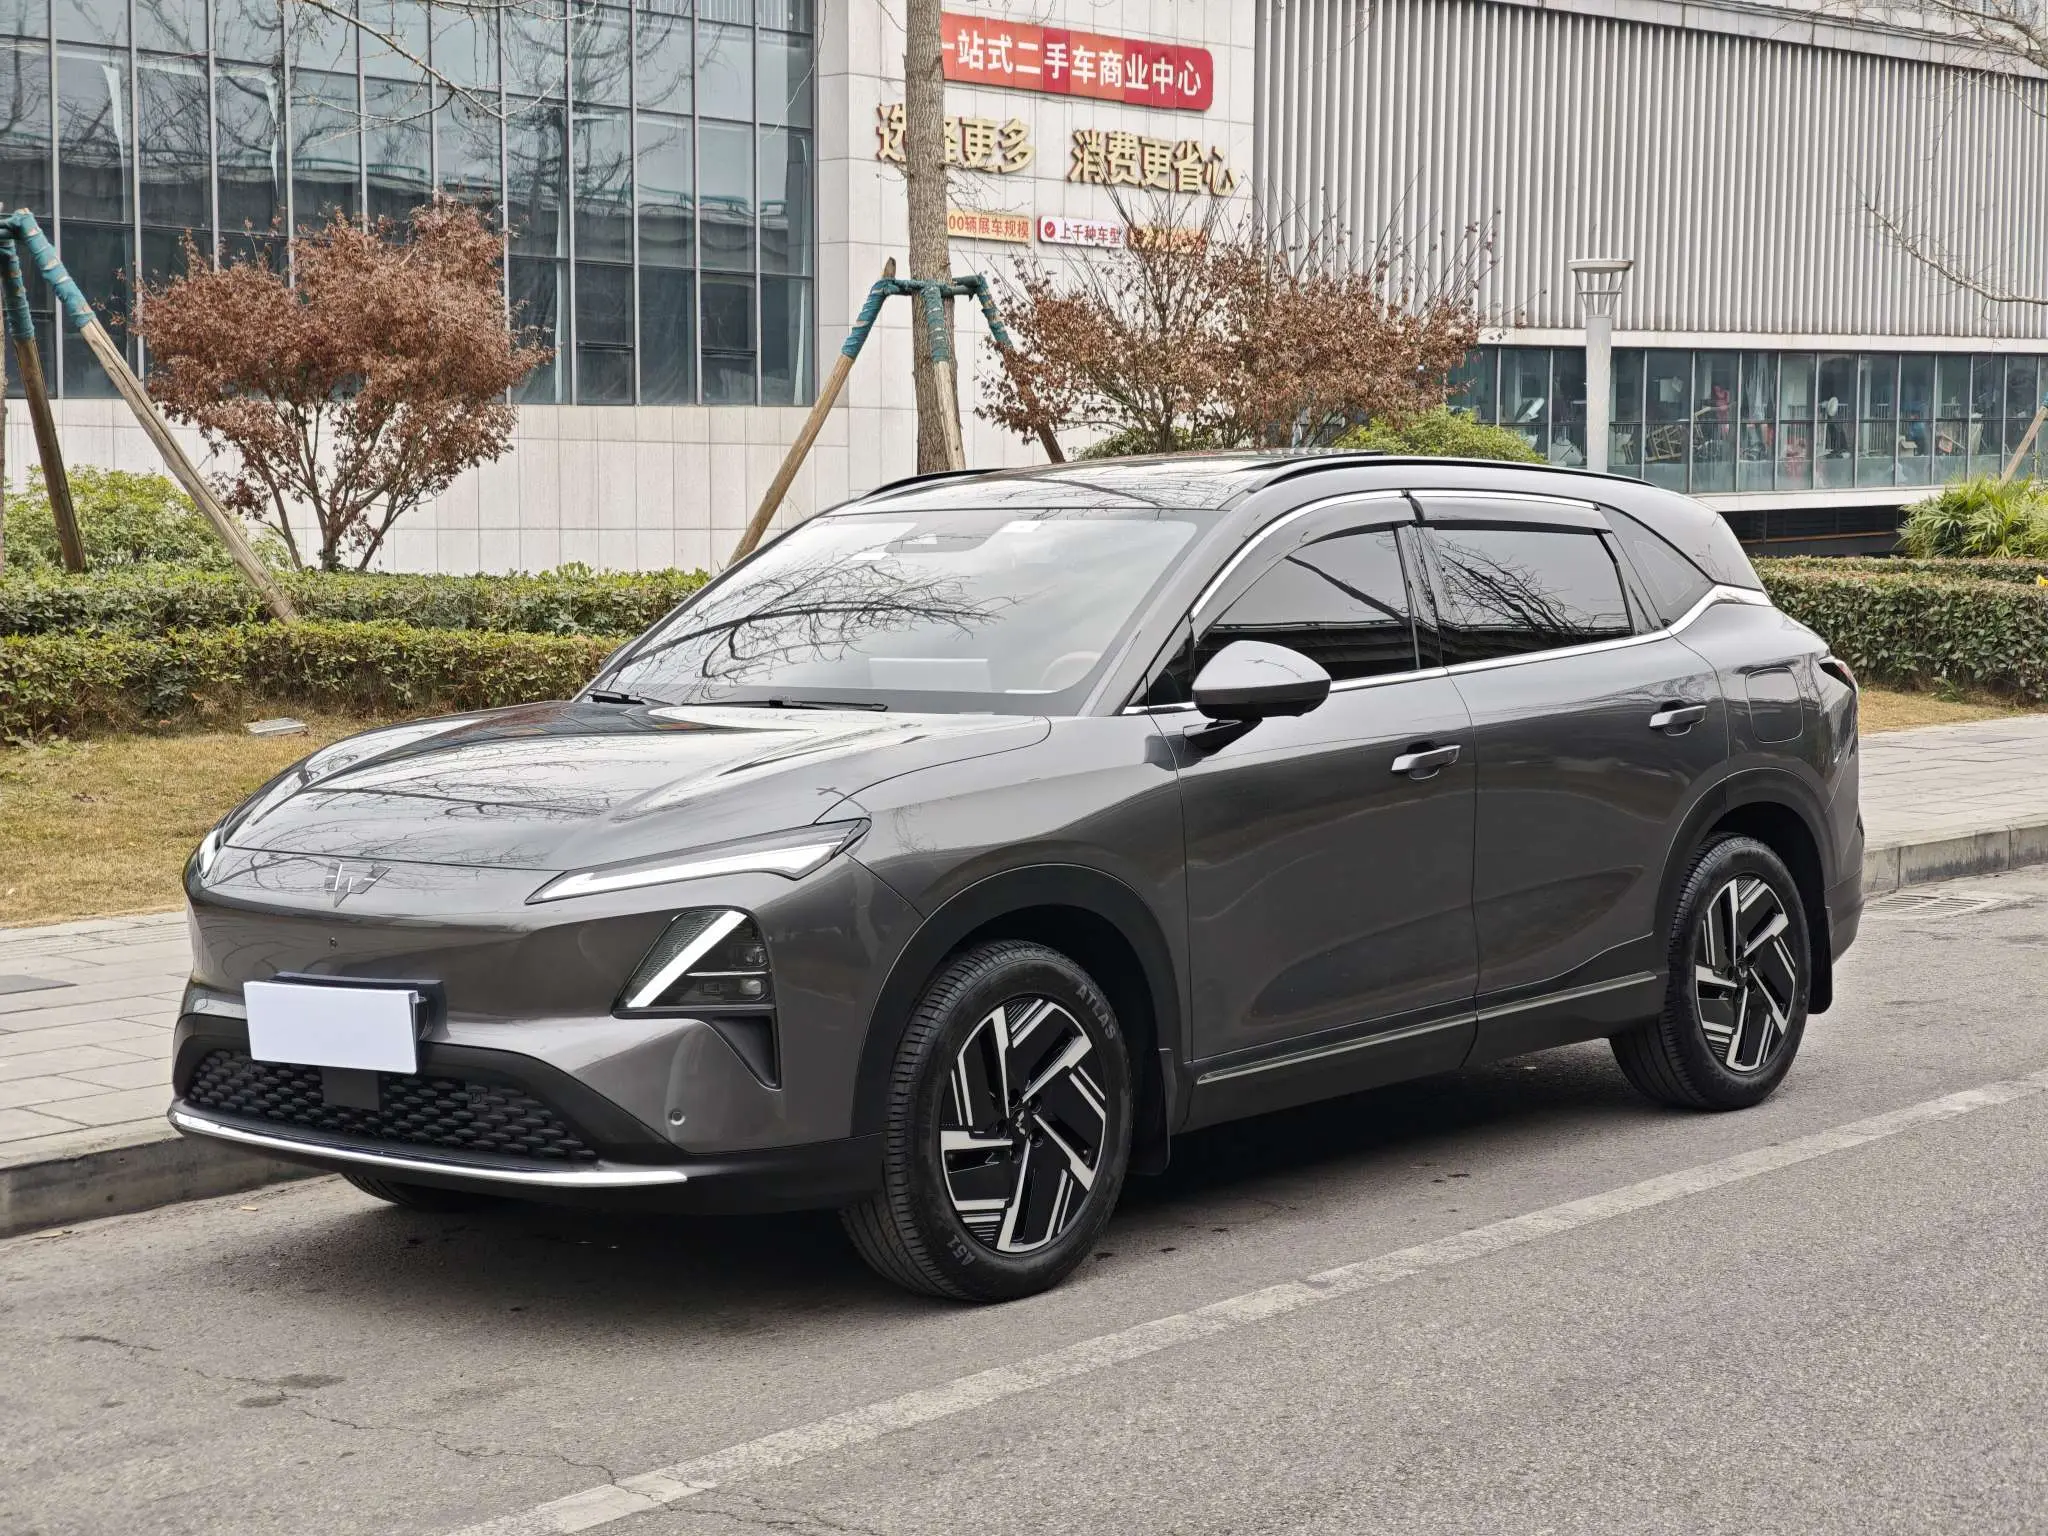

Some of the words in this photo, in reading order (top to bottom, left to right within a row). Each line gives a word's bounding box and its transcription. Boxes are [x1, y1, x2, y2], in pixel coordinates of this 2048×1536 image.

[1067, 129, 1234, 197] 消费更省心
[1060, 221, 1121, 245] 上千种车型
[1075, 983, 1116, 1040] ATLAS
